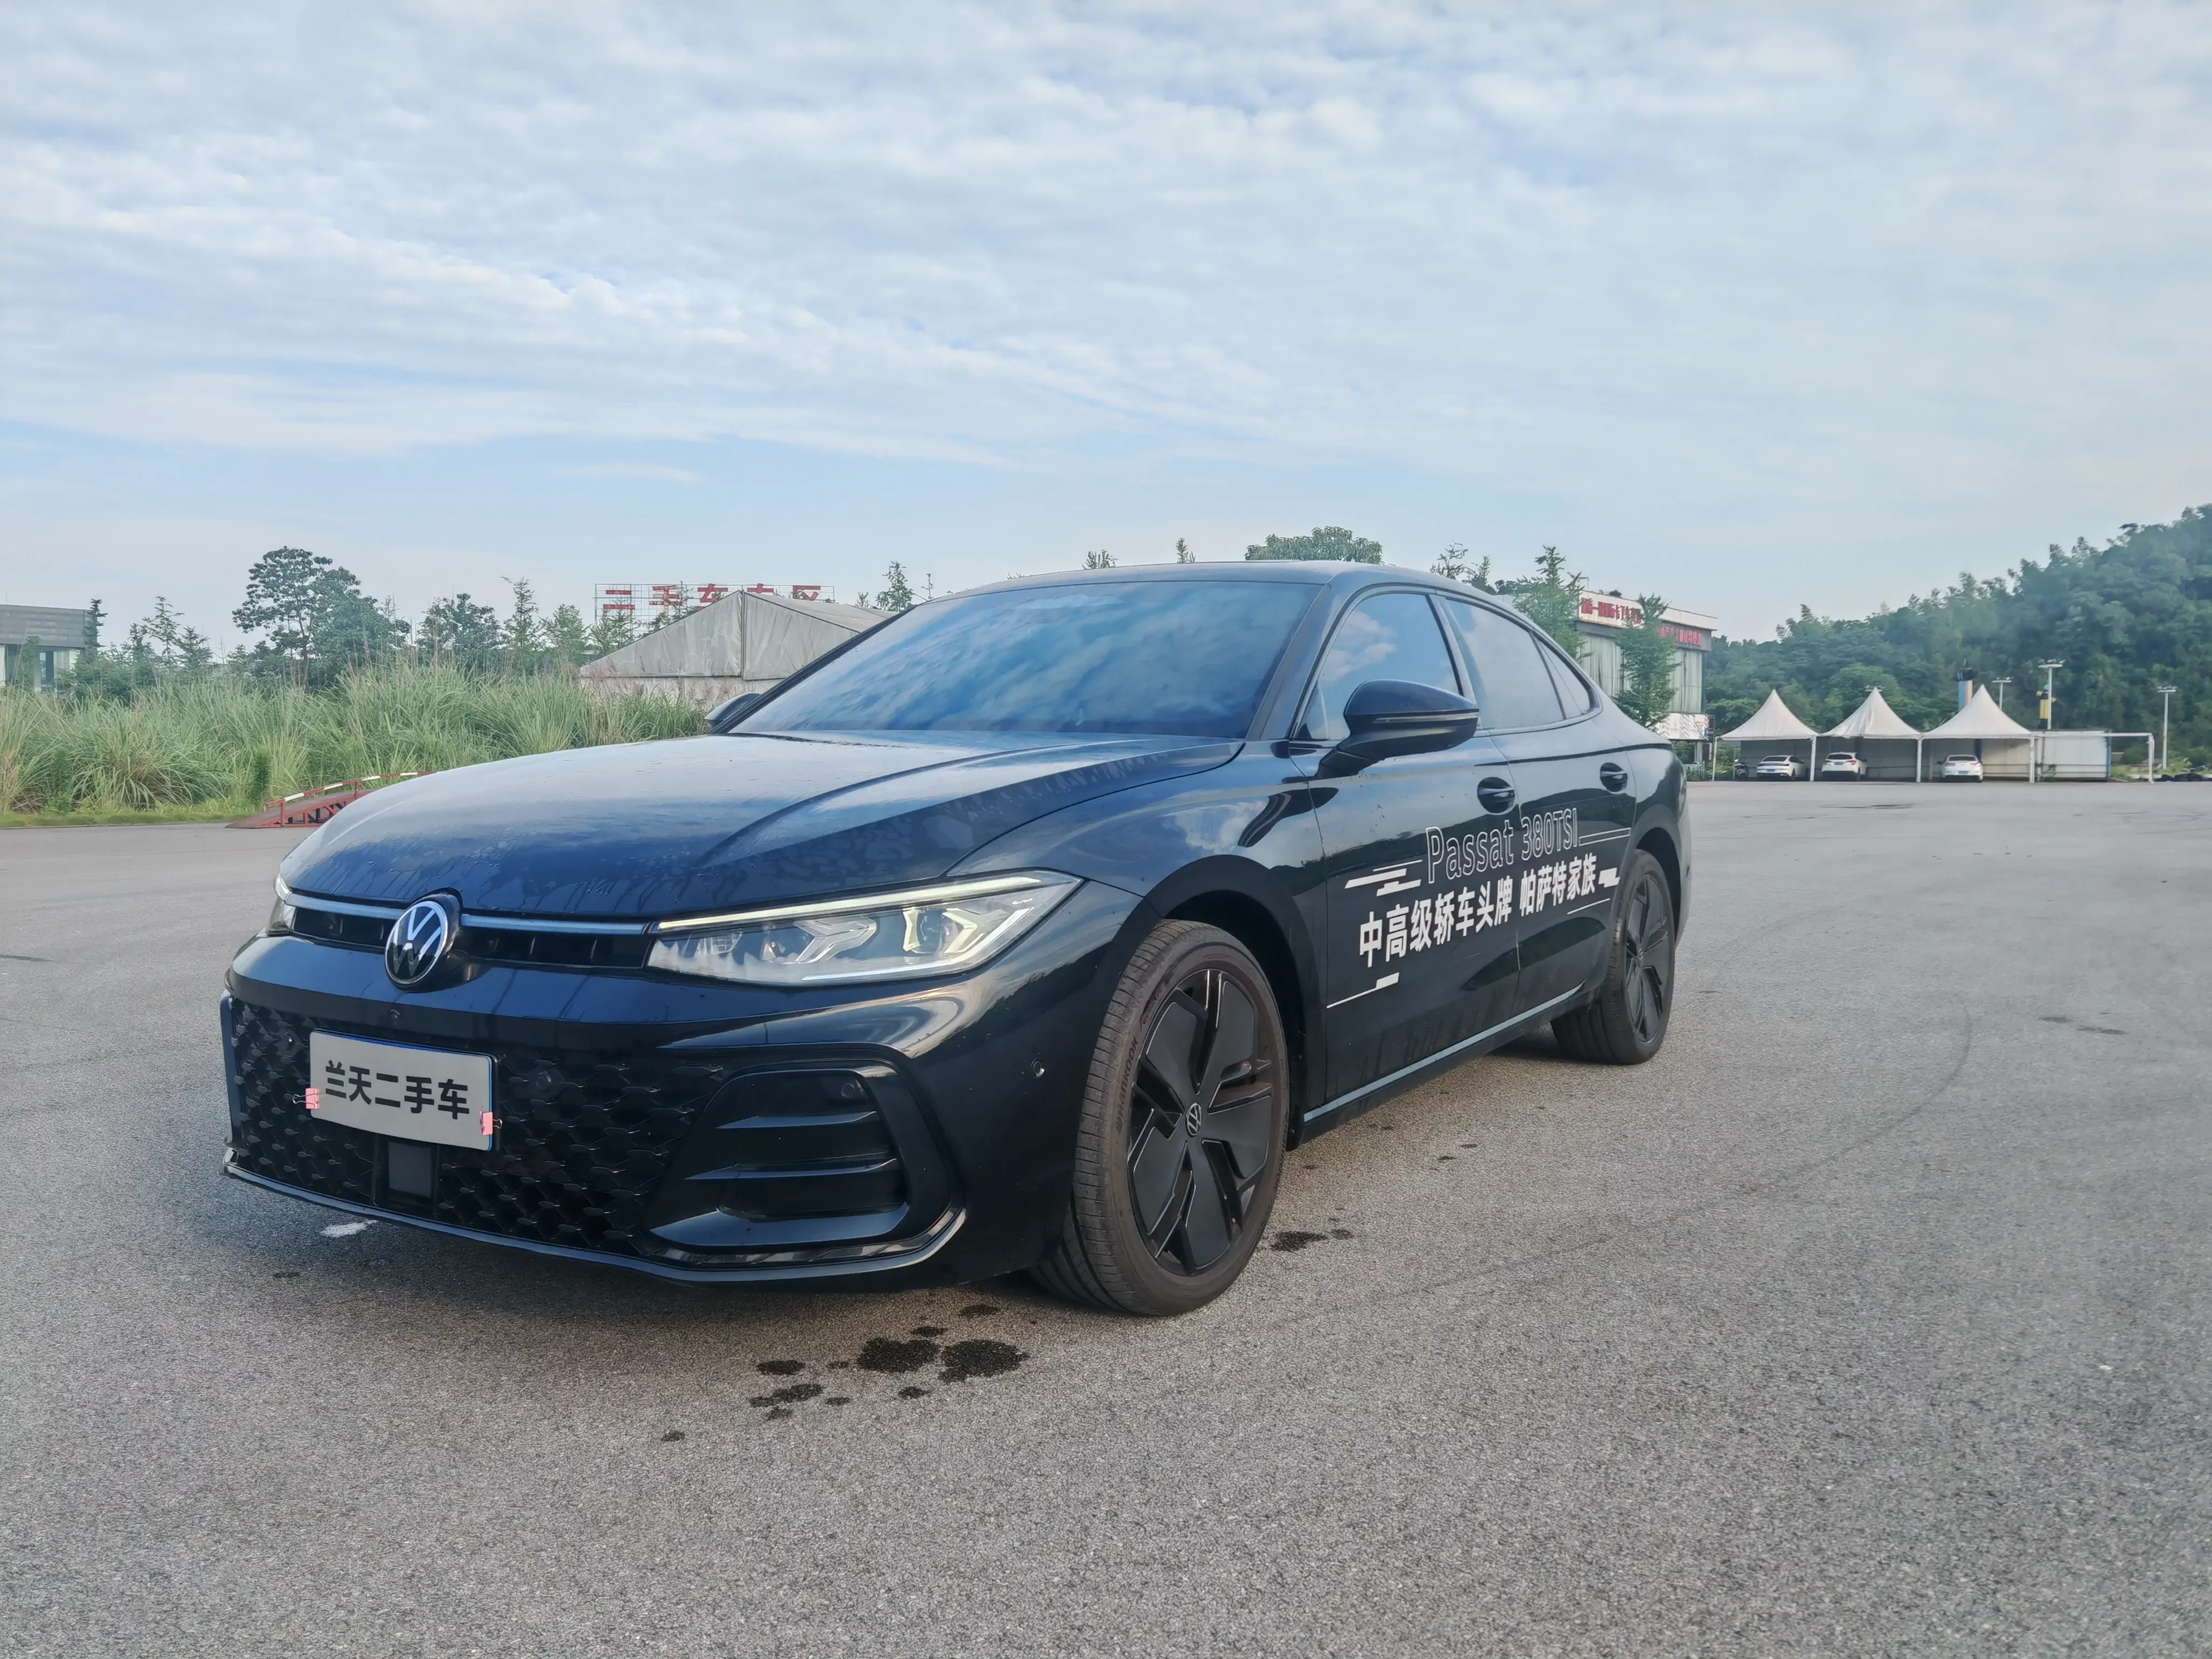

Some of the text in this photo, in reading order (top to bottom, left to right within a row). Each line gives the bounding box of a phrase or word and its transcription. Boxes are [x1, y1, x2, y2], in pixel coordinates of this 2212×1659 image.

[1426, 807, 1578, 884] Passat 380TSI
[1359, 852, 1597, 968] 中高级轿车头牌 帕萨特家族
[325, 1060, 470, 1120] 兰天二手车
